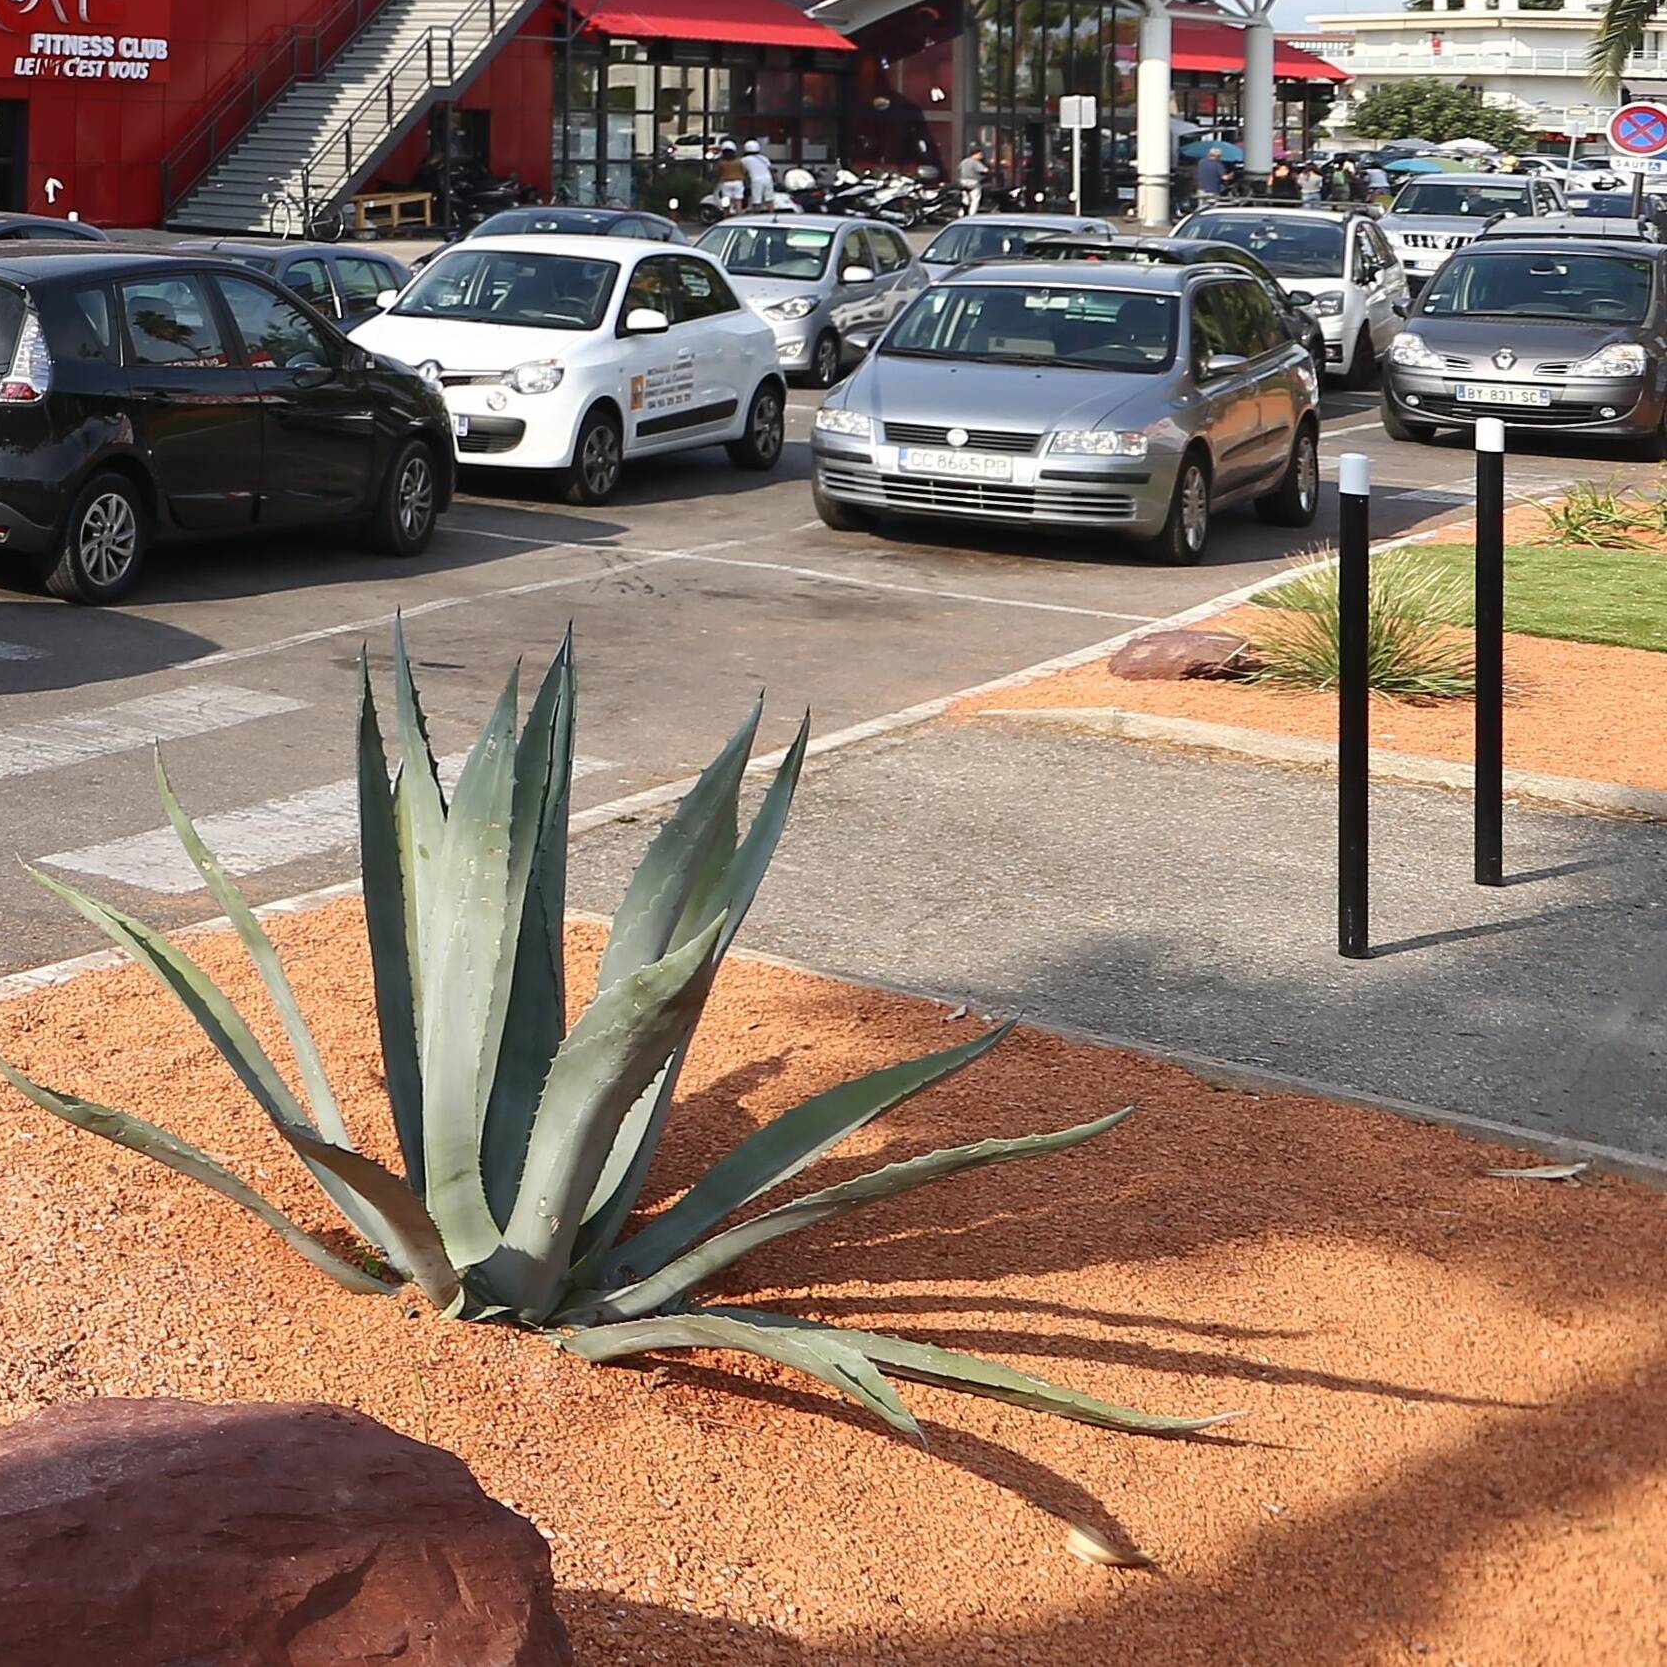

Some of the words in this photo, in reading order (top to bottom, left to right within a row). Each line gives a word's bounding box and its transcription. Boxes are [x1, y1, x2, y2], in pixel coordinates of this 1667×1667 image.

[30, 33, 115, 58] FITNESS
[119, 37, 168, 59] CLUB
[14, 57, 35, 75] LE
[63, 57, 106, 78] C'EST
[108, 61, 150, 79] VOUS
[1615, 160, 1646, 169] SAUF
[910, 451, 933, 468] CC
